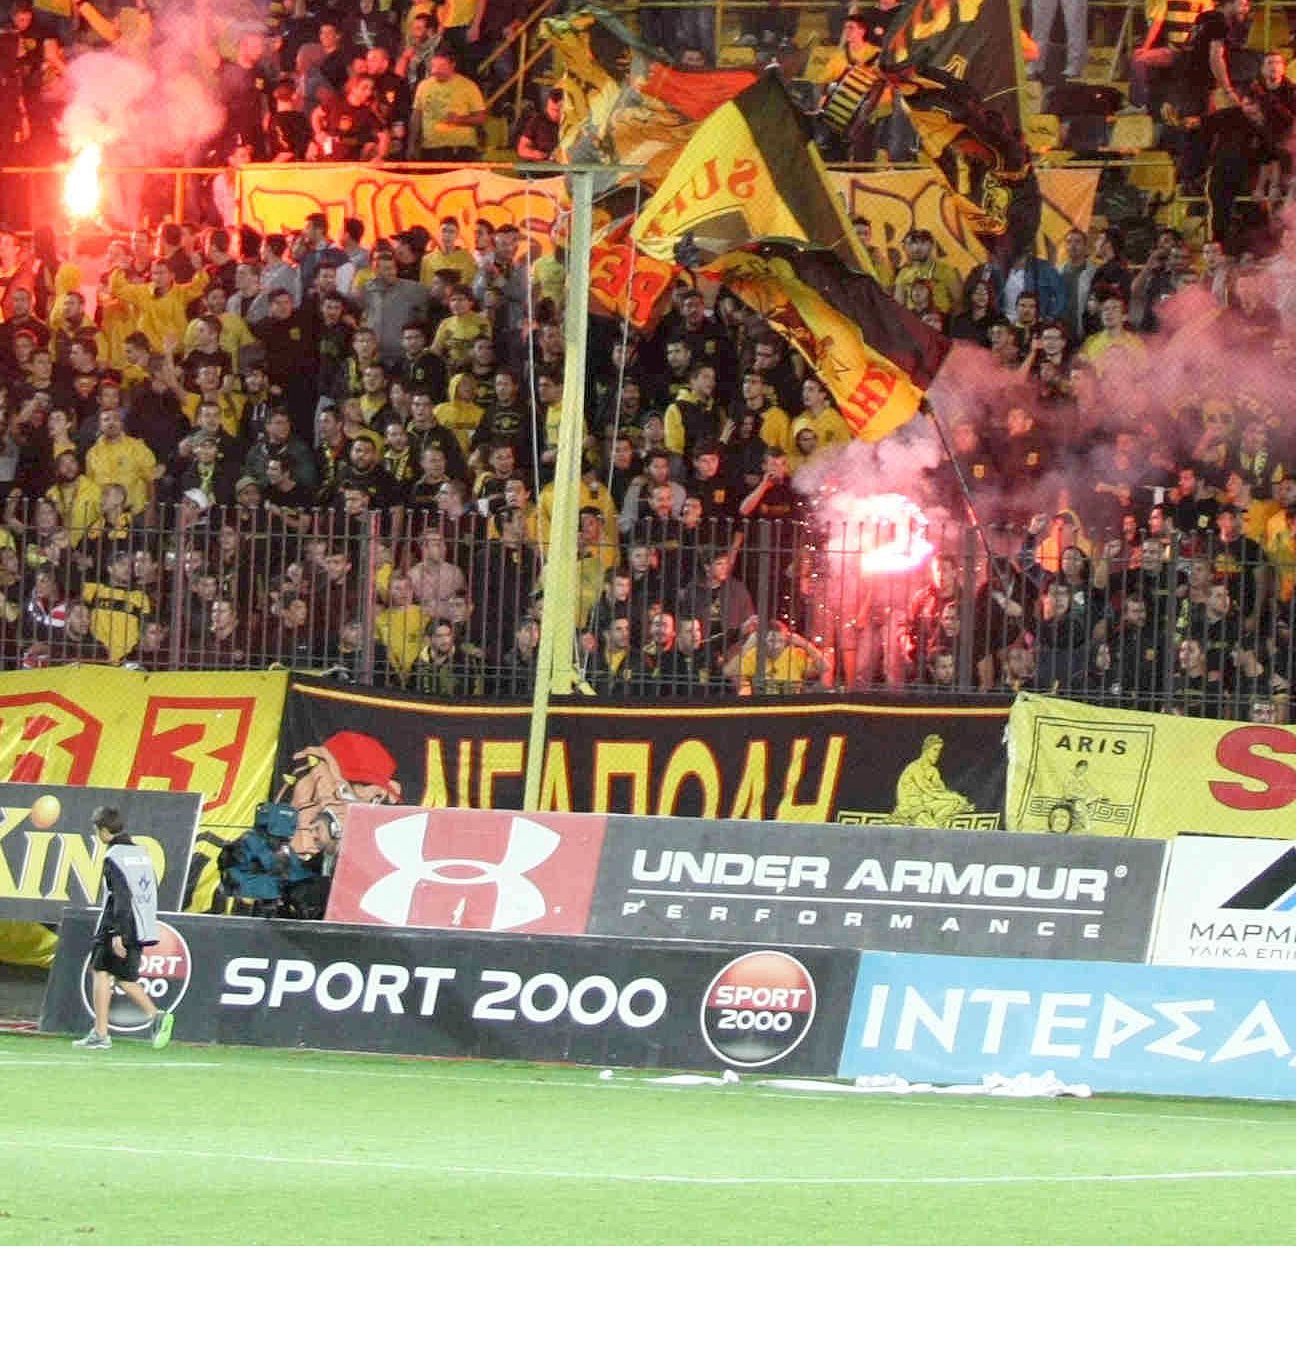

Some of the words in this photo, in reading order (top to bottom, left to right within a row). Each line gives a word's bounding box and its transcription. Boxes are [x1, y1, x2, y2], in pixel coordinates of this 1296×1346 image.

[1055, 734, 1128, 756] ARIS
[632, 849, 830, 890] UNDER
[844, 859, 1108, 902] ARMOUR
[622, 899, 1104, 940] PERFORMANCE
[1189, 945, 1249, 959] ΥΛΙΚΑ
[220, 956, 456, 1016] SPORT
[472, 970, 668, 1028] 2000
[714, 984, 808, 1009] SPORT
[717, 1008, 793, 1033] 2000
